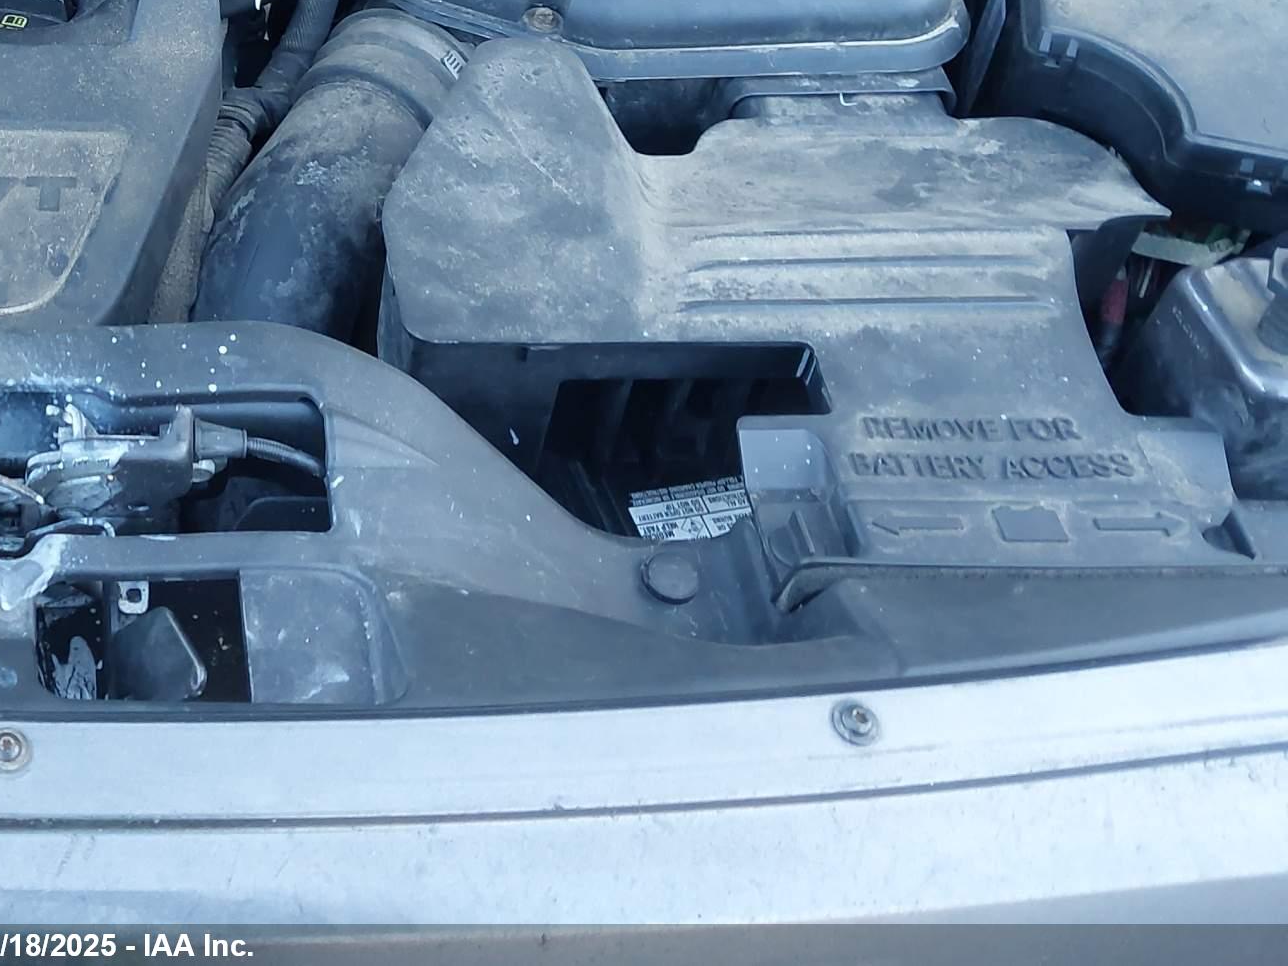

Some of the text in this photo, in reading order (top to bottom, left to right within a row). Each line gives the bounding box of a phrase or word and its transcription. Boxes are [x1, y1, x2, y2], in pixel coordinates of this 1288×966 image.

[861, 416, 1082, 442] REMOVE FOR
[847, 452, 1137, 479] BATTERY ACCESS
